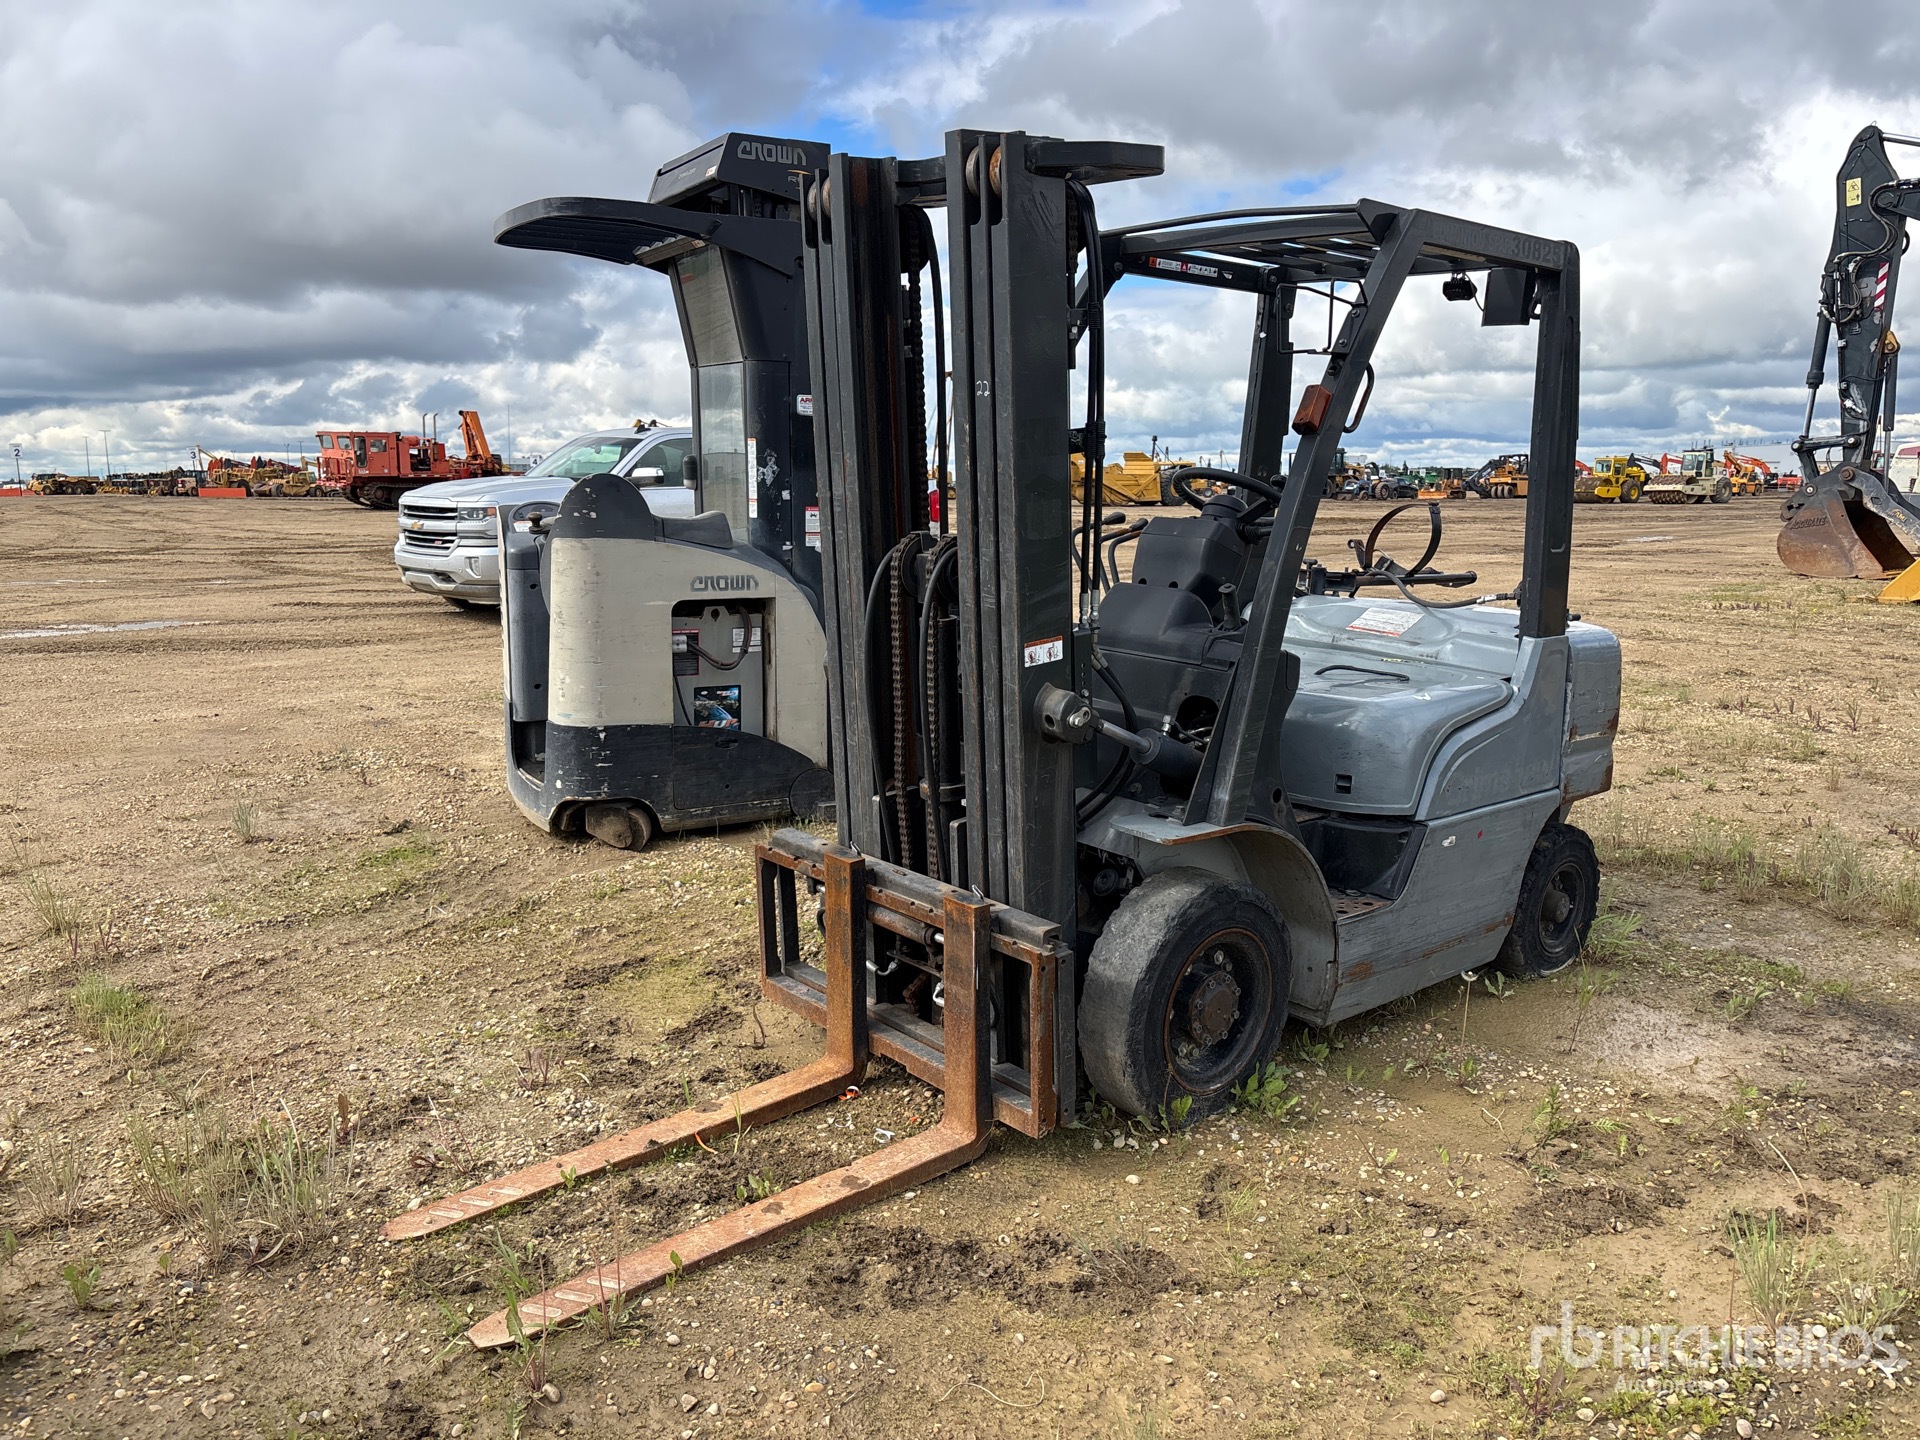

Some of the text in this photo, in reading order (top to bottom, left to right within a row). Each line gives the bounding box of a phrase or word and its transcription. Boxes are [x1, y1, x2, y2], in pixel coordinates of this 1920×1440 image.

[737, 141, 807, 166] CROWN
[1511, 235, 1562, 268] 30825
[14, 448, 21, 457] 2
[190, 451, 197, 459] 3
[689, 574, 759, 592] CROWN
